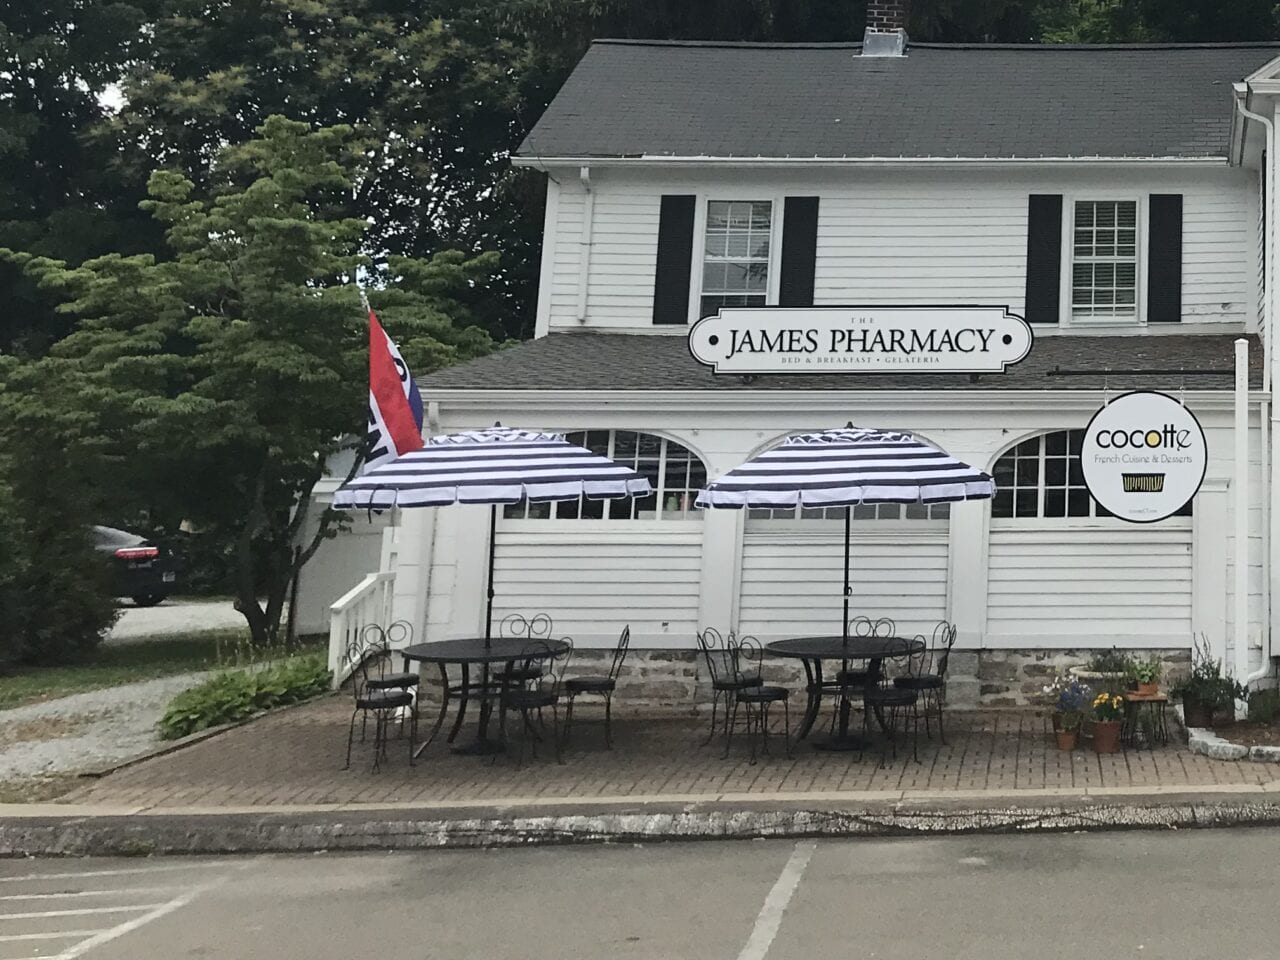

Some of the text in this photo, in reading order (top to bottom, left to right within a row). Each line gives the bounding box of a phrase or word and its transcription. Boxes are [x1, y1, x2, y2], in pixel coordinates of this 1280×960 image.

[726, 328, 996, 359] JAMES PHARMACY
[1096, 424, 1192, 451] cocotte
[1094, 453, 1193, 463] French Cuisine & Desserts
